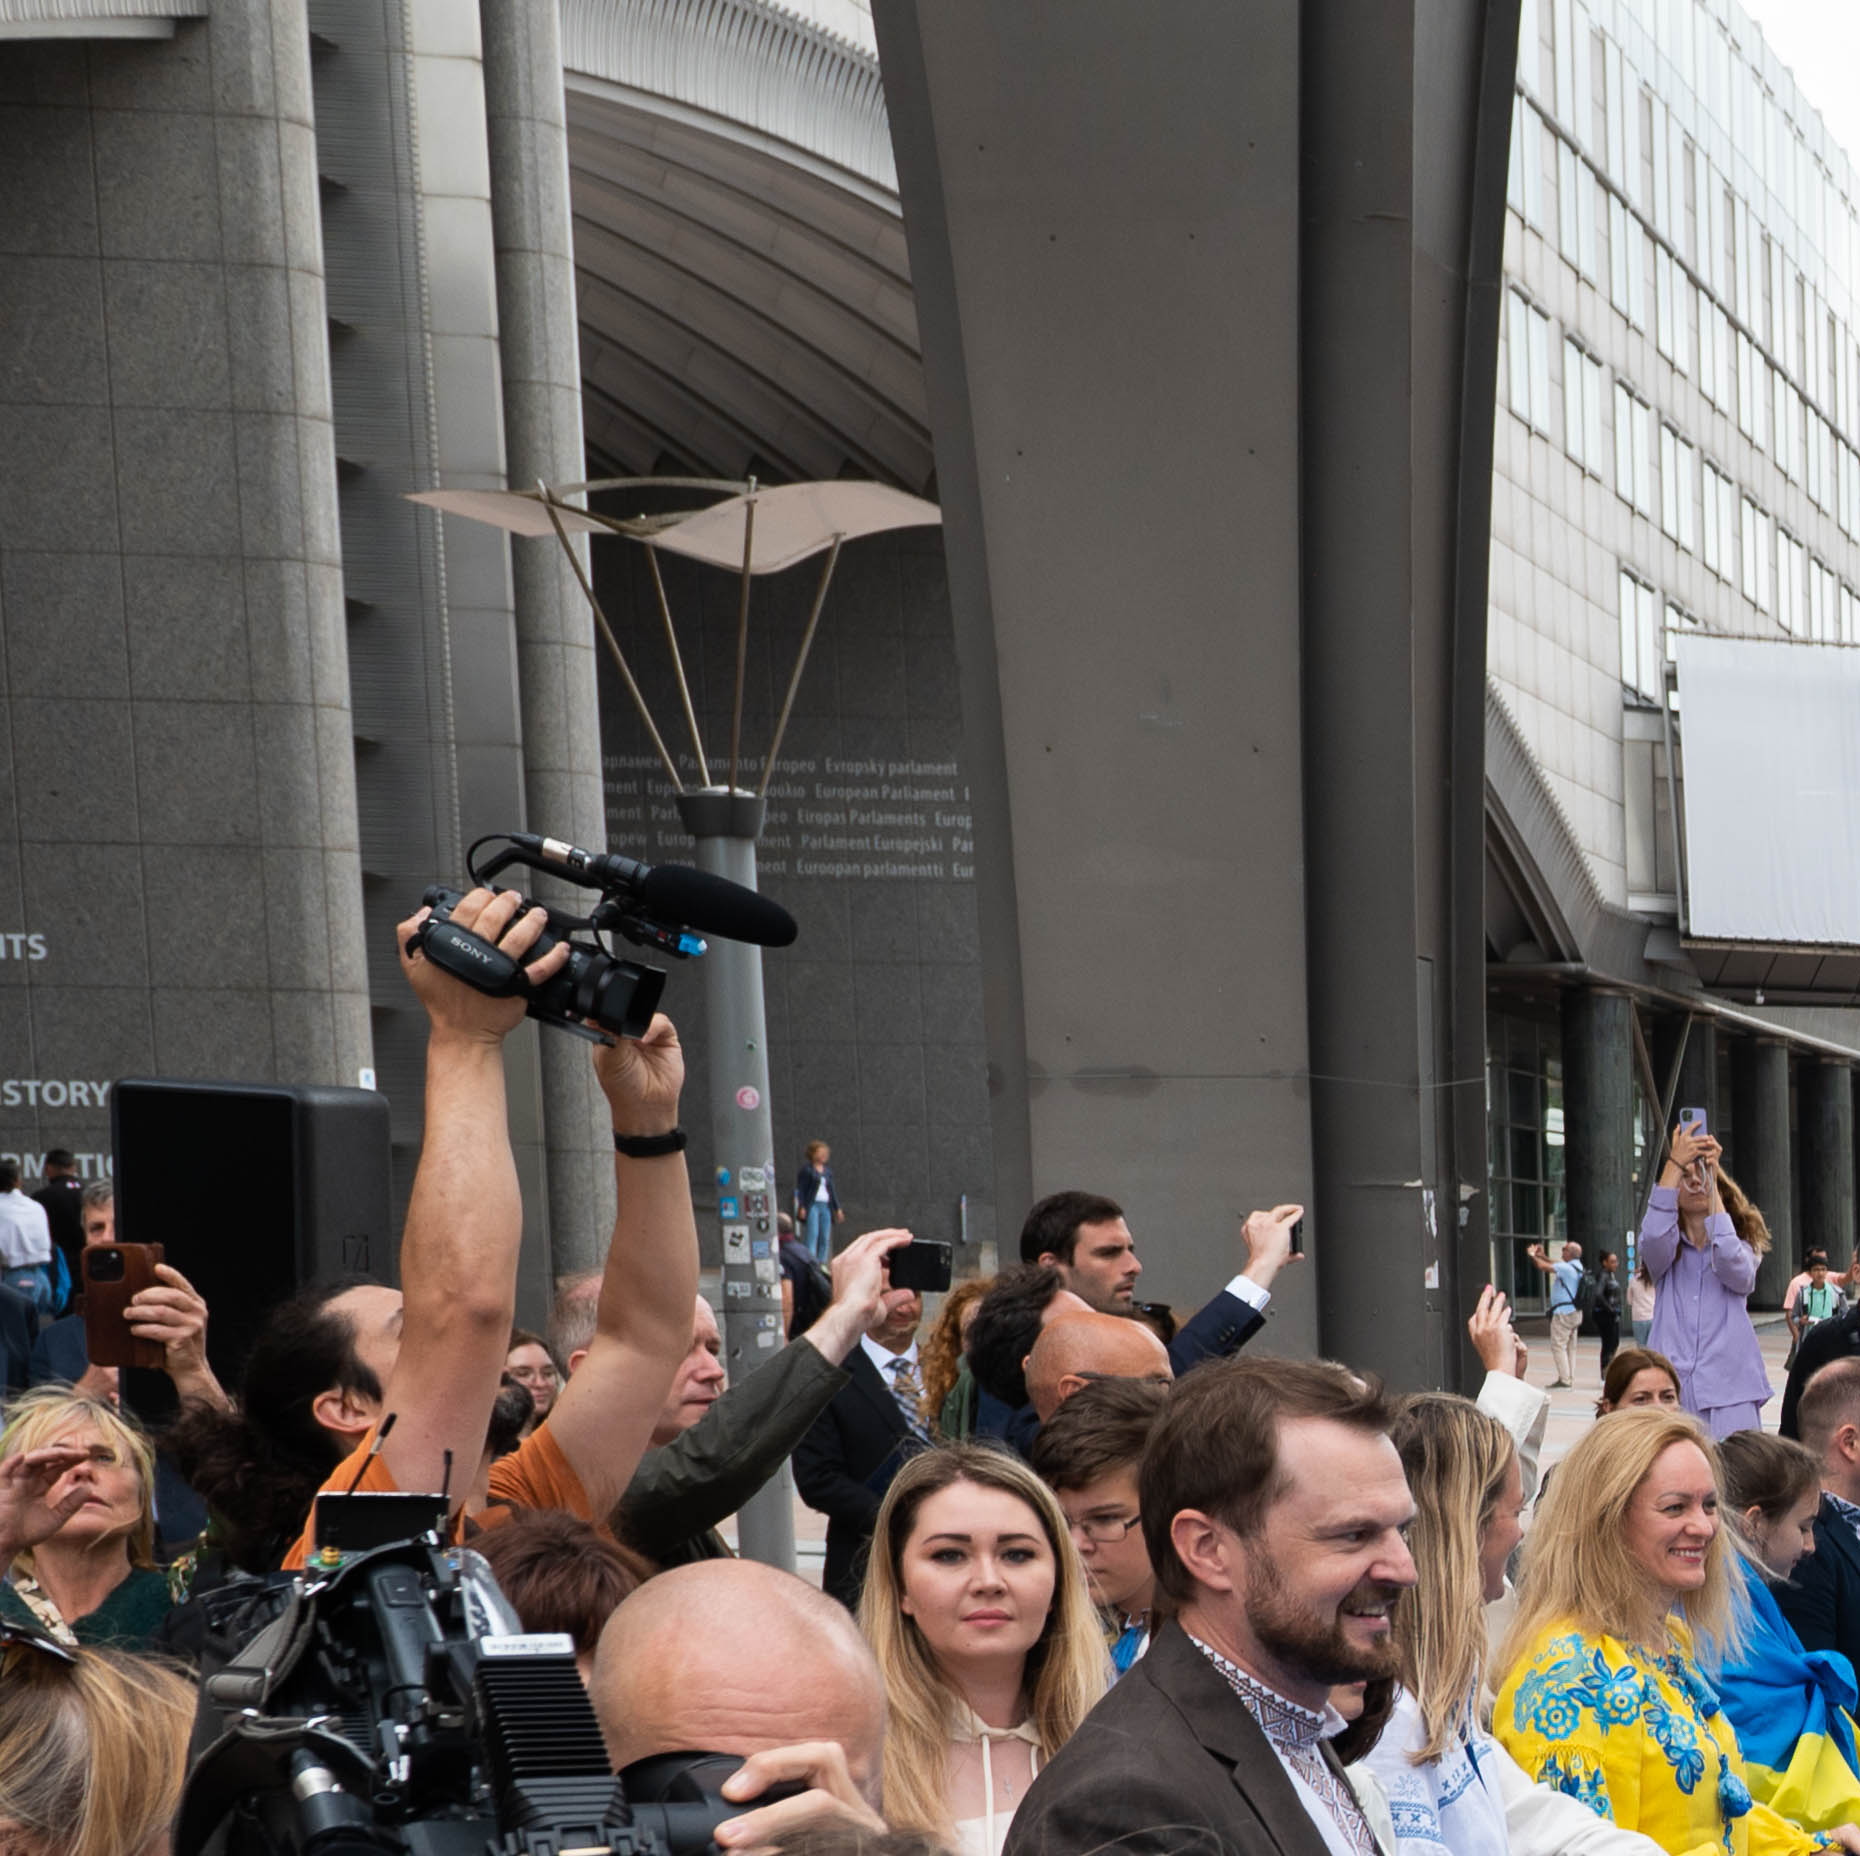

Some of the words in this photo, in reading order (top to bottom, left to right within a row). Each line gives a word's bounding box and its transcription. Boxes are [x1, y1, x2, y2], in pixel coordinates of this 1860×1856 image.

[889, 760, 958, 777] parlament
[815, 782, 878, 802] European
[881, 783, 955, 801] Parliament
[797, 808, 846, 827] Eiropas
[849, 808, 926, 826] Parlaments
[801, 833, 870, 851] Parlament
[873, 833, 944, 854] Europejski
[796, 858, 861, 879] Euroopan
[863, 861, 944, 879] parlamentti
[450, 936, 493, 965] SONY
